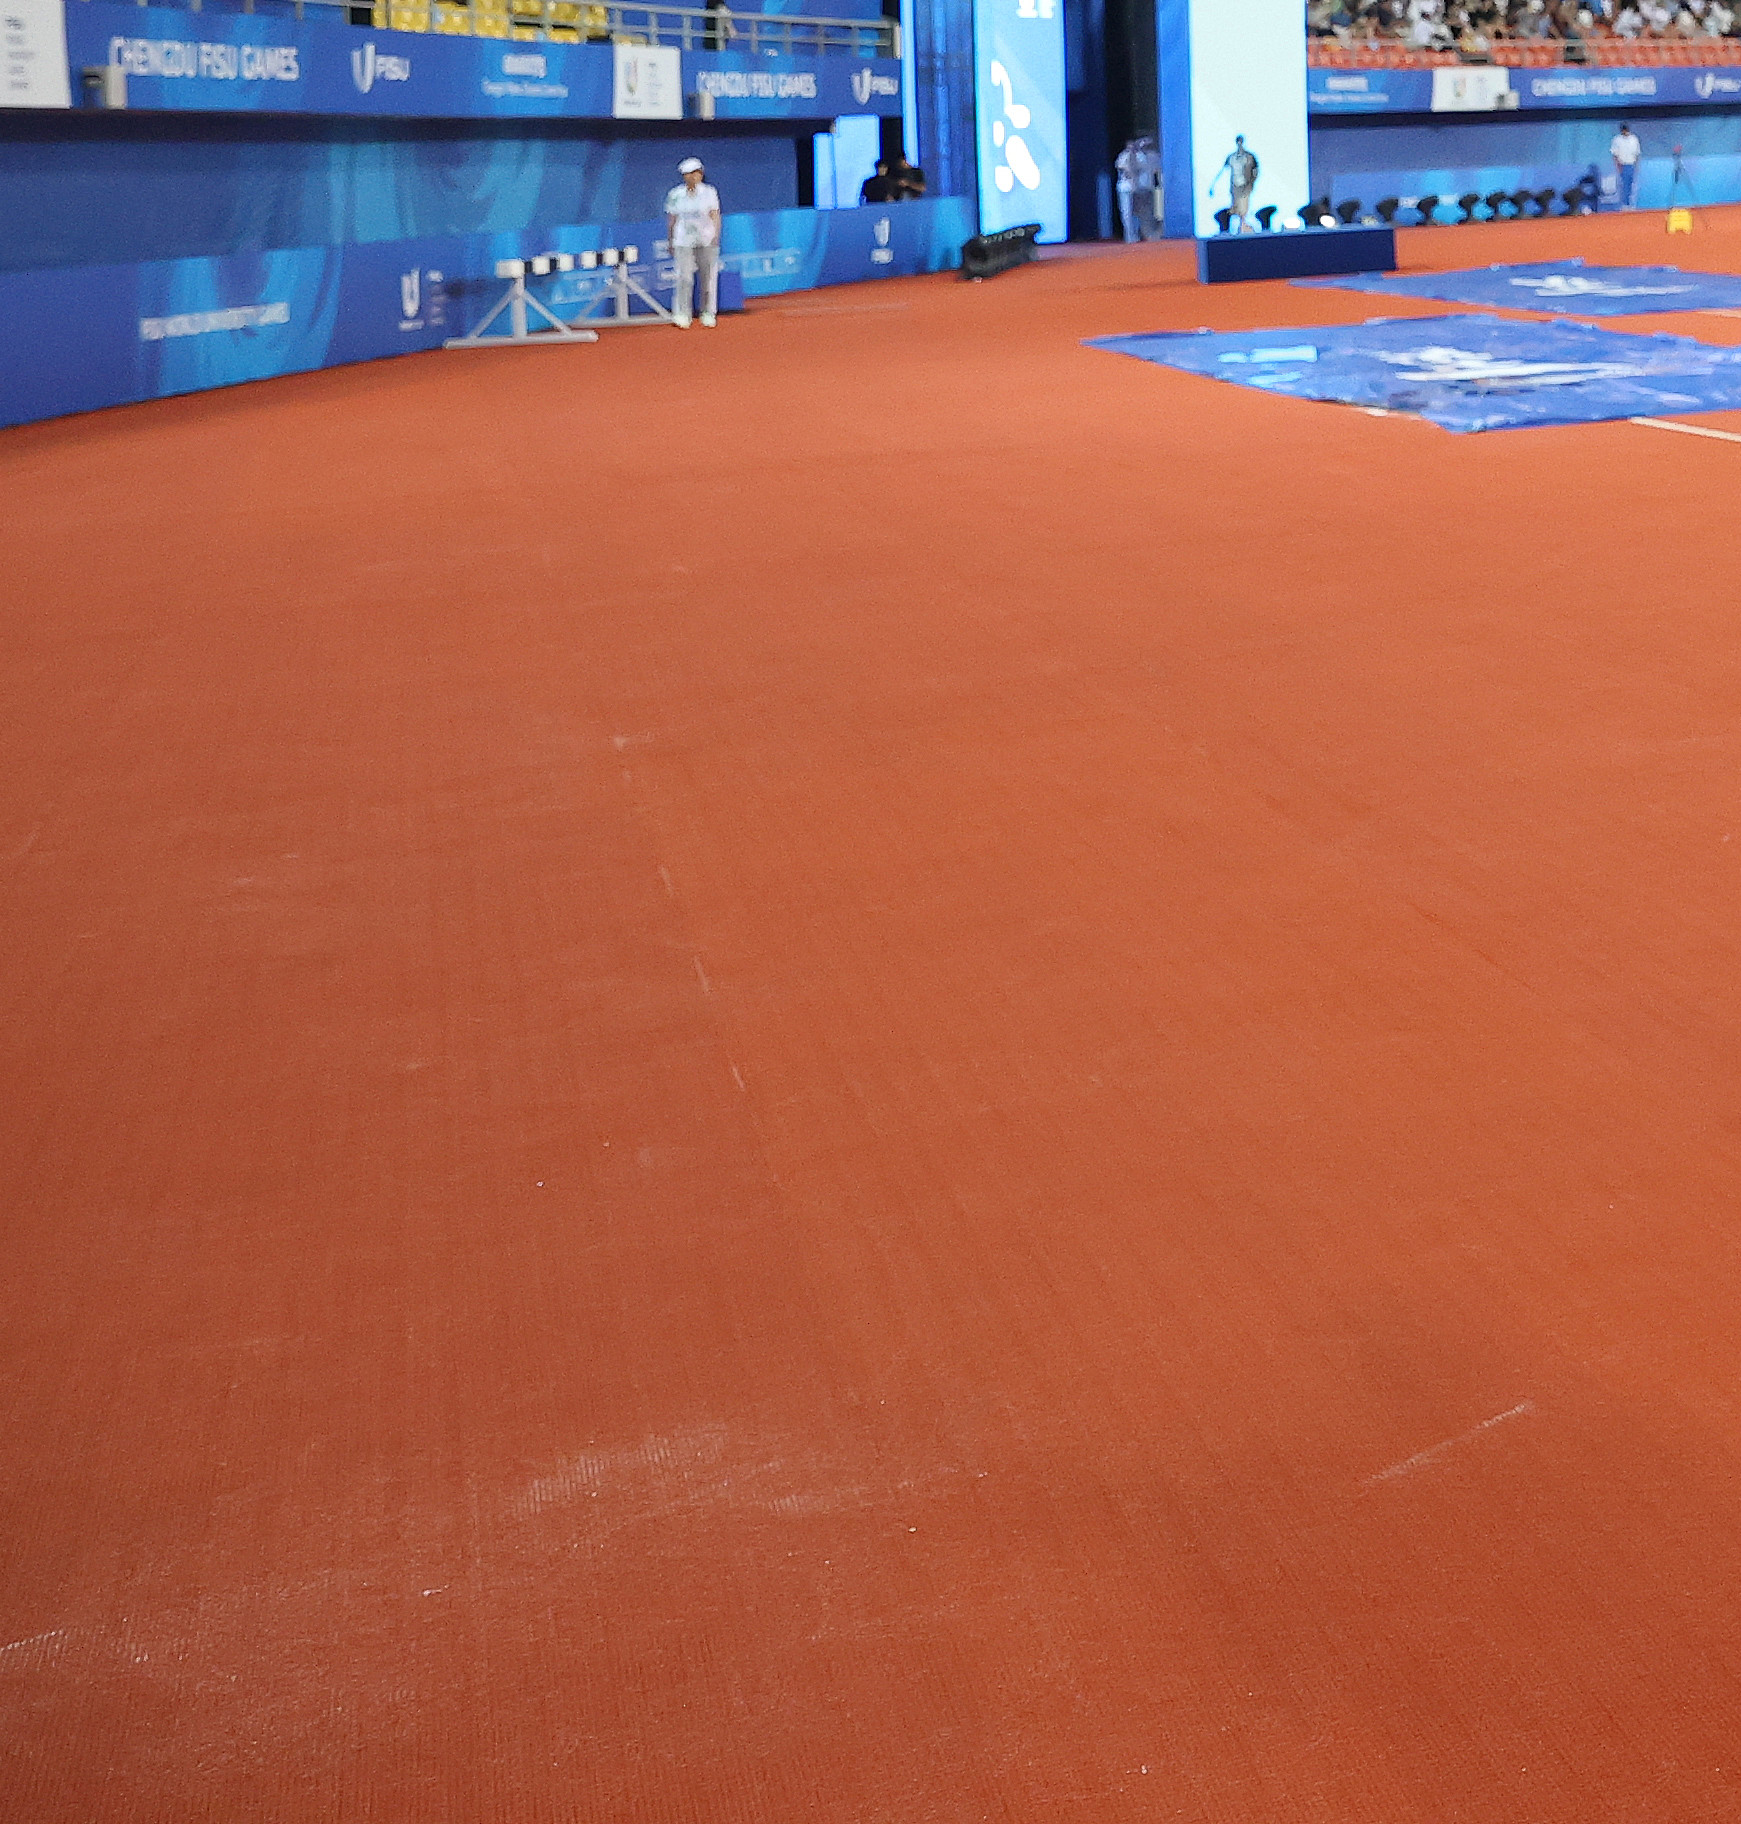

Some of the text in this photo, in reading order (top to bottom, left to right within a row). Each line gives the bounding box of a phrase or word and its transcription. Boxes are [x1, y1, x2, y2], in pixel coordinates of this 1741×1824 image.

[109, 36, 299, 81] CHENGDU FISU GAMES
